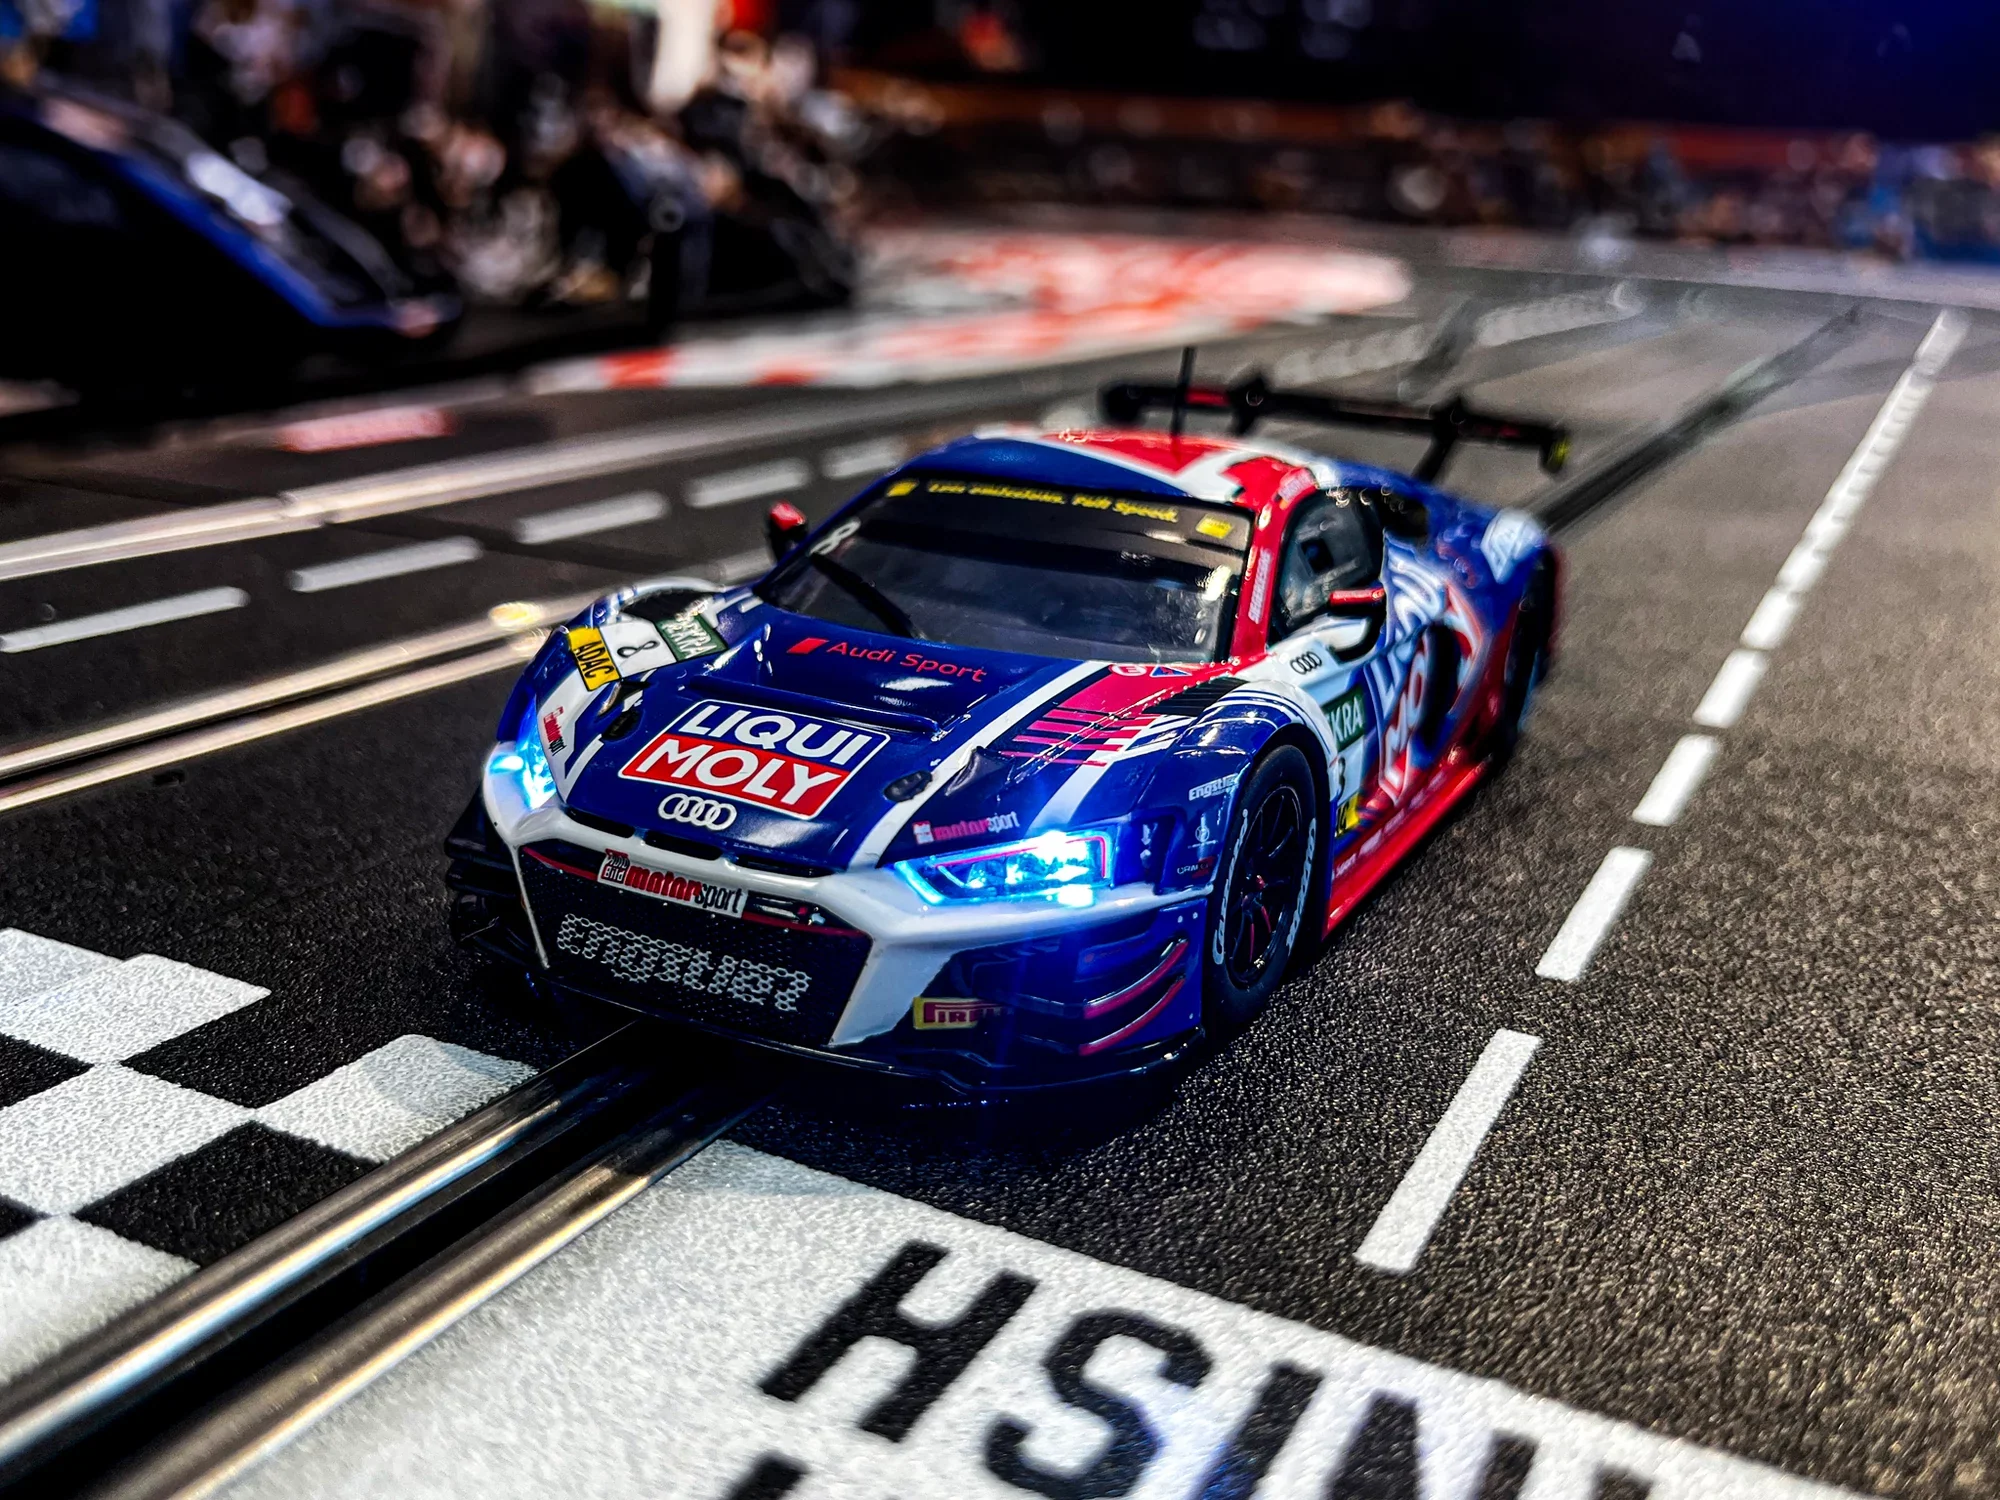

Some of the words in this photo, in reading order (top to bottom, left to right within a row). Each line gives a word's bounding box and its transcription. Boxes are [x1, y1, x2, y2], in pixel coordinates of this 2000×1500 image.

[574, 640, 615, 679] ADAC
[827, 642, 897, 663] Audi
[900, 654, 987, 683] Sport
[678, 705, 873, 766] LIQUI
[635, 738, 843, 806] MOLY
[603, 865, 626, 882] Bild
[624, 865, 743, 914] motorsport
